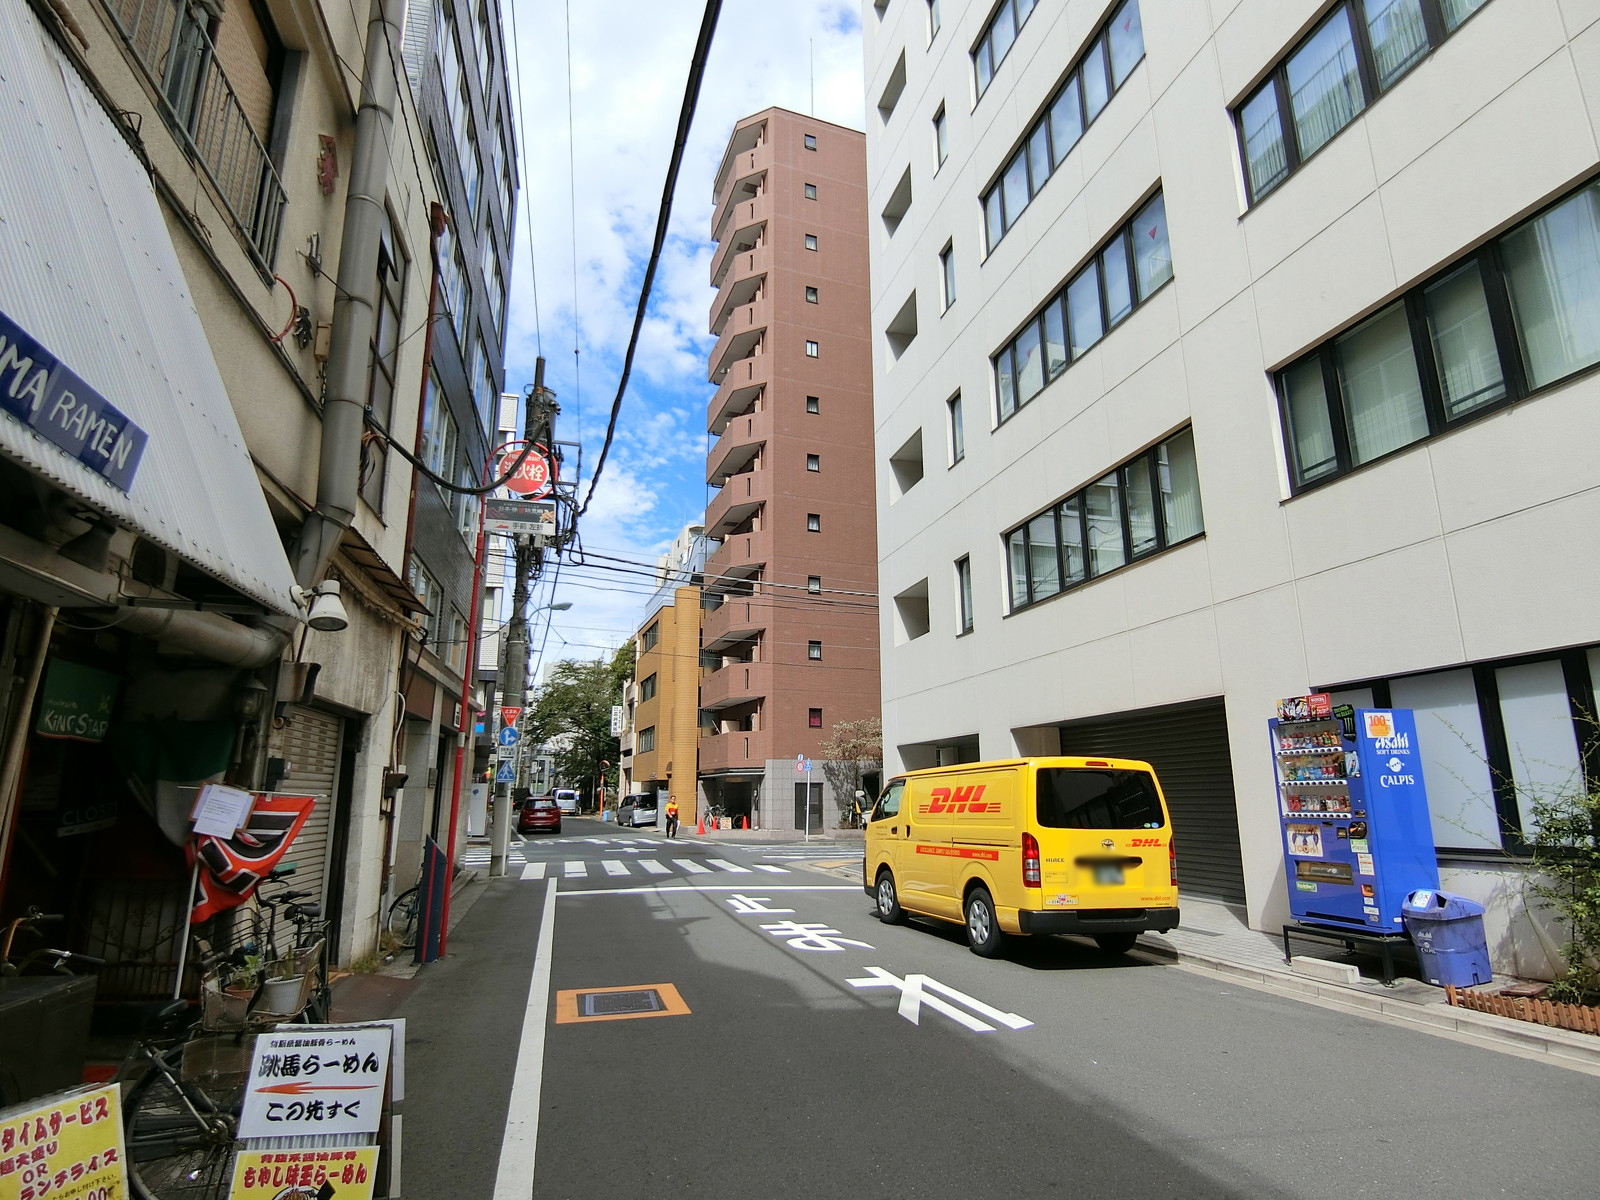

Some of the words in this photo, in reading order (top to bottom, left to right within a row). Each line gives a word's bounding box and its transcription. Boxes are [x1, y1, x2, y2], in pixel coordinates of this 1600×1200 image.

[0, 335, 49, 412] MA
[49, 390, 133, 470] RAMEN
[1380, 774, 1415, 788] CALPIS
[928, 784, 987, 813] DHL
[1131, 838, 1162, 847] DHL
[258, 1051, 379, 1078] 跳馬らーめん
[265, 1099, 361, 1122] この先すぐ
[1, 1096, 109, 1154] タイムサービス
[22, 1162, 49, 1184] OR
